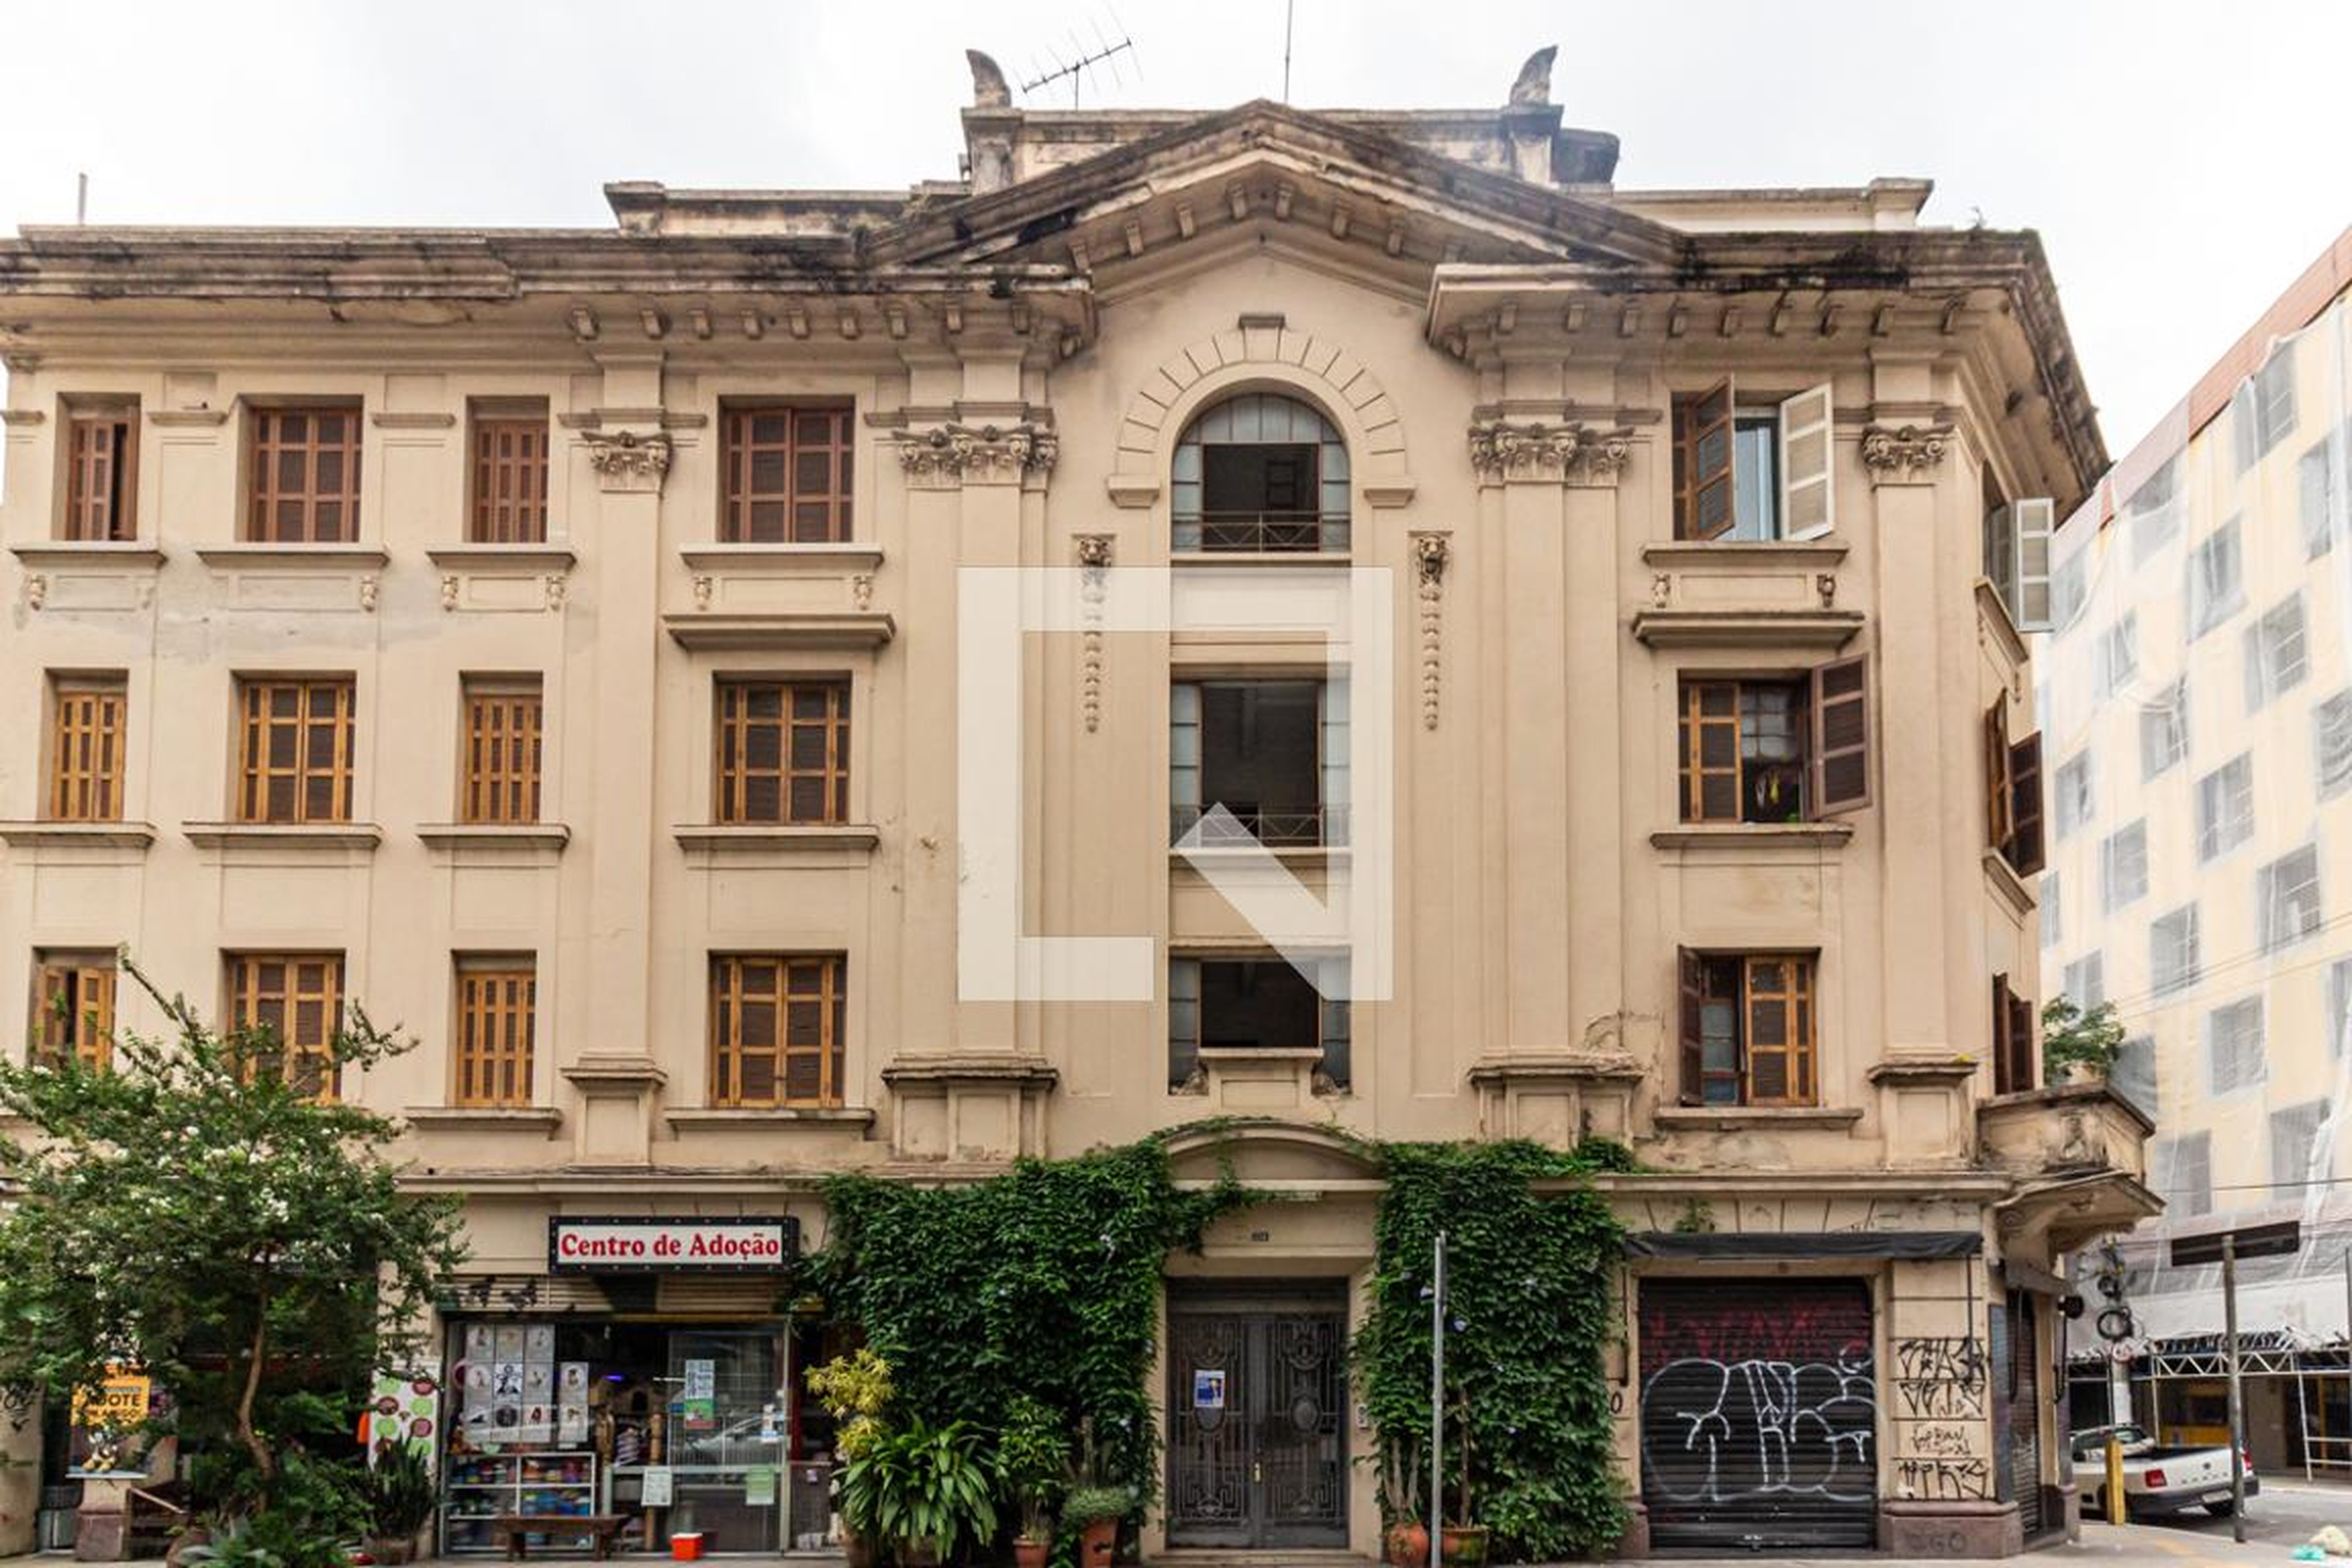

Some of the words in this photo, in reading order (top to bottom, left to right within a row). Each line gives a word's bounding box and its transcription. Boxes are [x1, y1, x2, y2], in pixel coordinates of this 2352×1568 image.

[560, 1233, 646, 1256] Centro
[653, 1234, 682, 1256] de
[689, 1232, 780, 1261] Adoção
